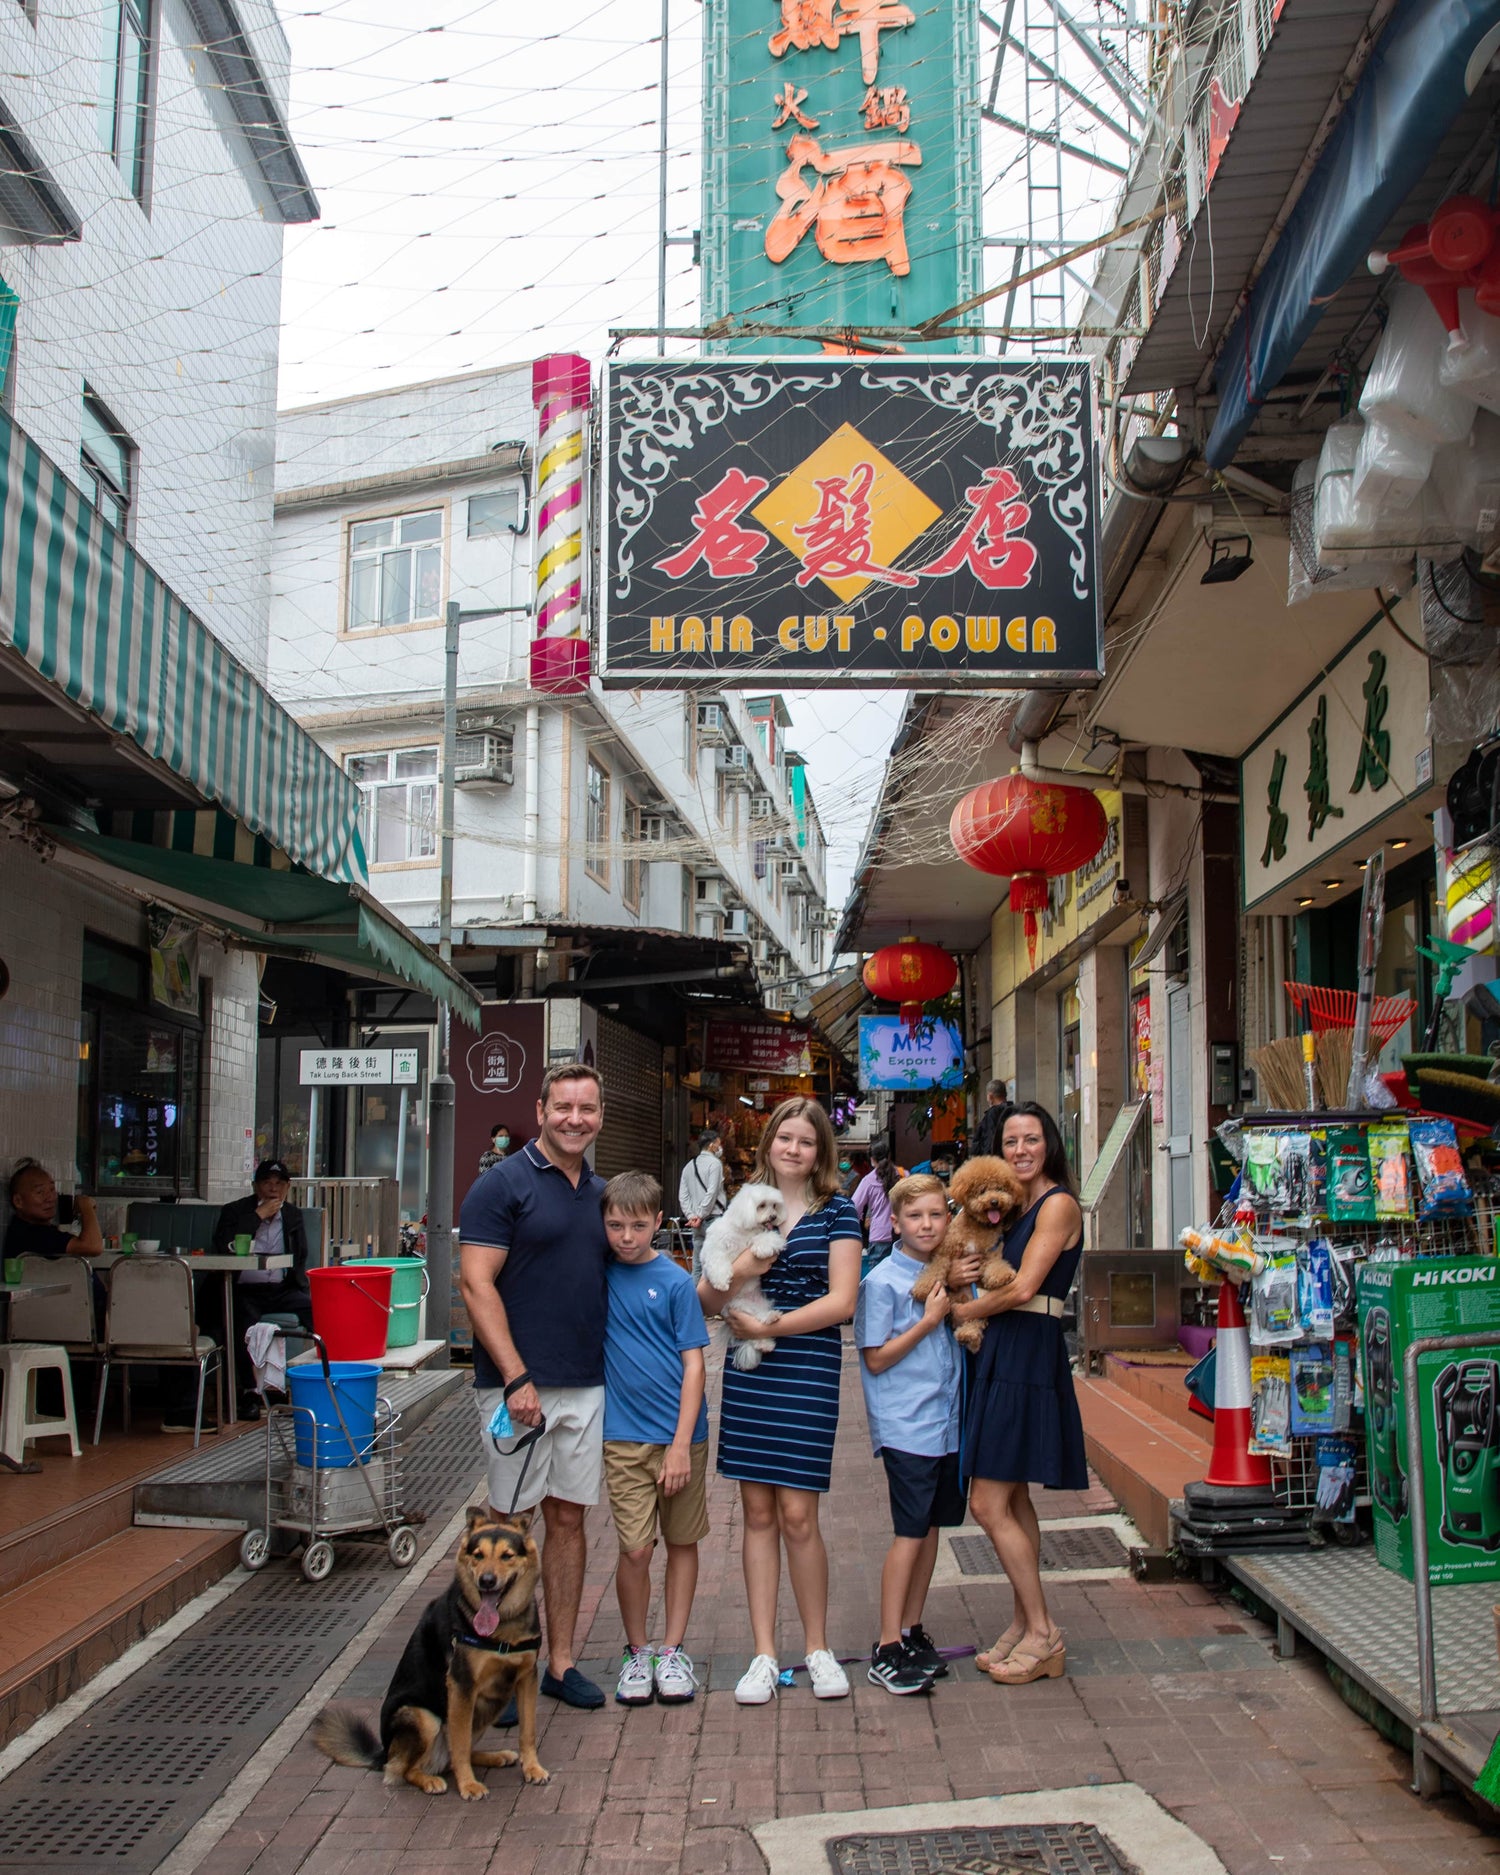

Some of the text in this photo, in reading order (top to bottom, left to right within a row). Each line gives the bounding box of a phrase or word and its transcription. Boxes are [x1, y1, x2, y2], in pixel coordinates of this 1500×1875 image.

[649, 615, 1058, 653] HAIR CUT POWER
[315, 1056, 377, 1069] 德隆後街
[487, 1055, 505, 1066] 街角
[888, 1055, 937, 1067] Export
[310, 1070, 382, 1080] Tak Lung Back Street
[487, 1067, 505, 1077] 小店
[1412, 1266, 1496, 1287] HiKOKI
